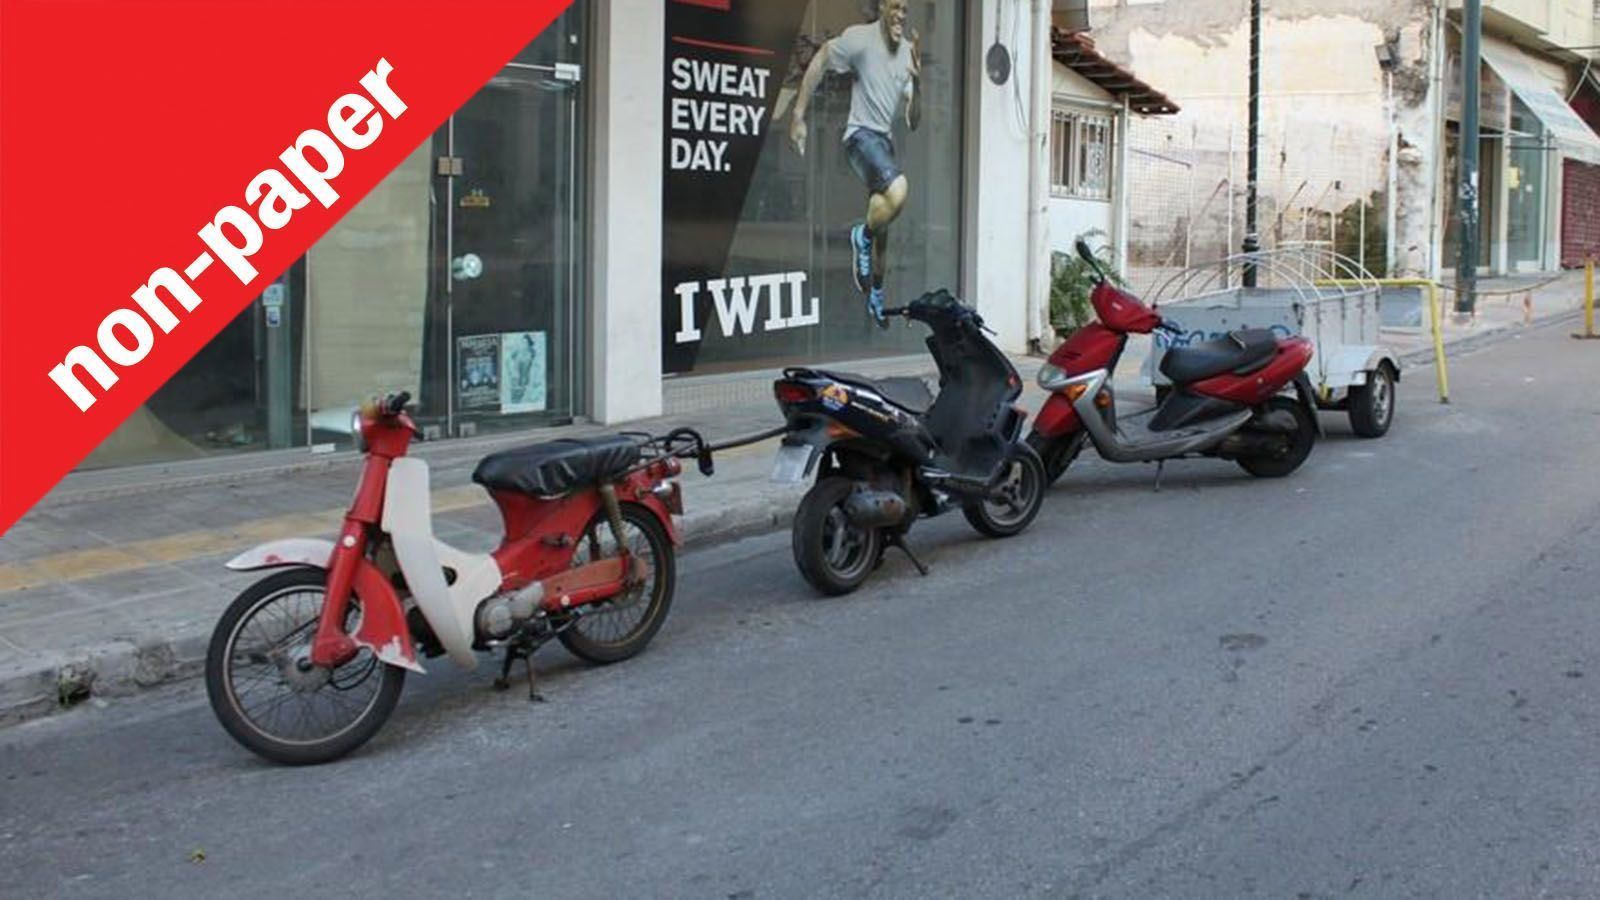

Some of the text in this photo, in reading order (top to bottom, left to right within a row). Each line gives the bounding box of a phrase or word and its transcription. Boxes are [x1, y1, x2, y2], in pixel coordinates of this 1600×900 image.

[671, 57, 770, 99] SWEAT
[671, 97, 766, 136] EVERY
[671, 137, 732, 173] DAY.
[674, 270, 820, 343] I WIL
